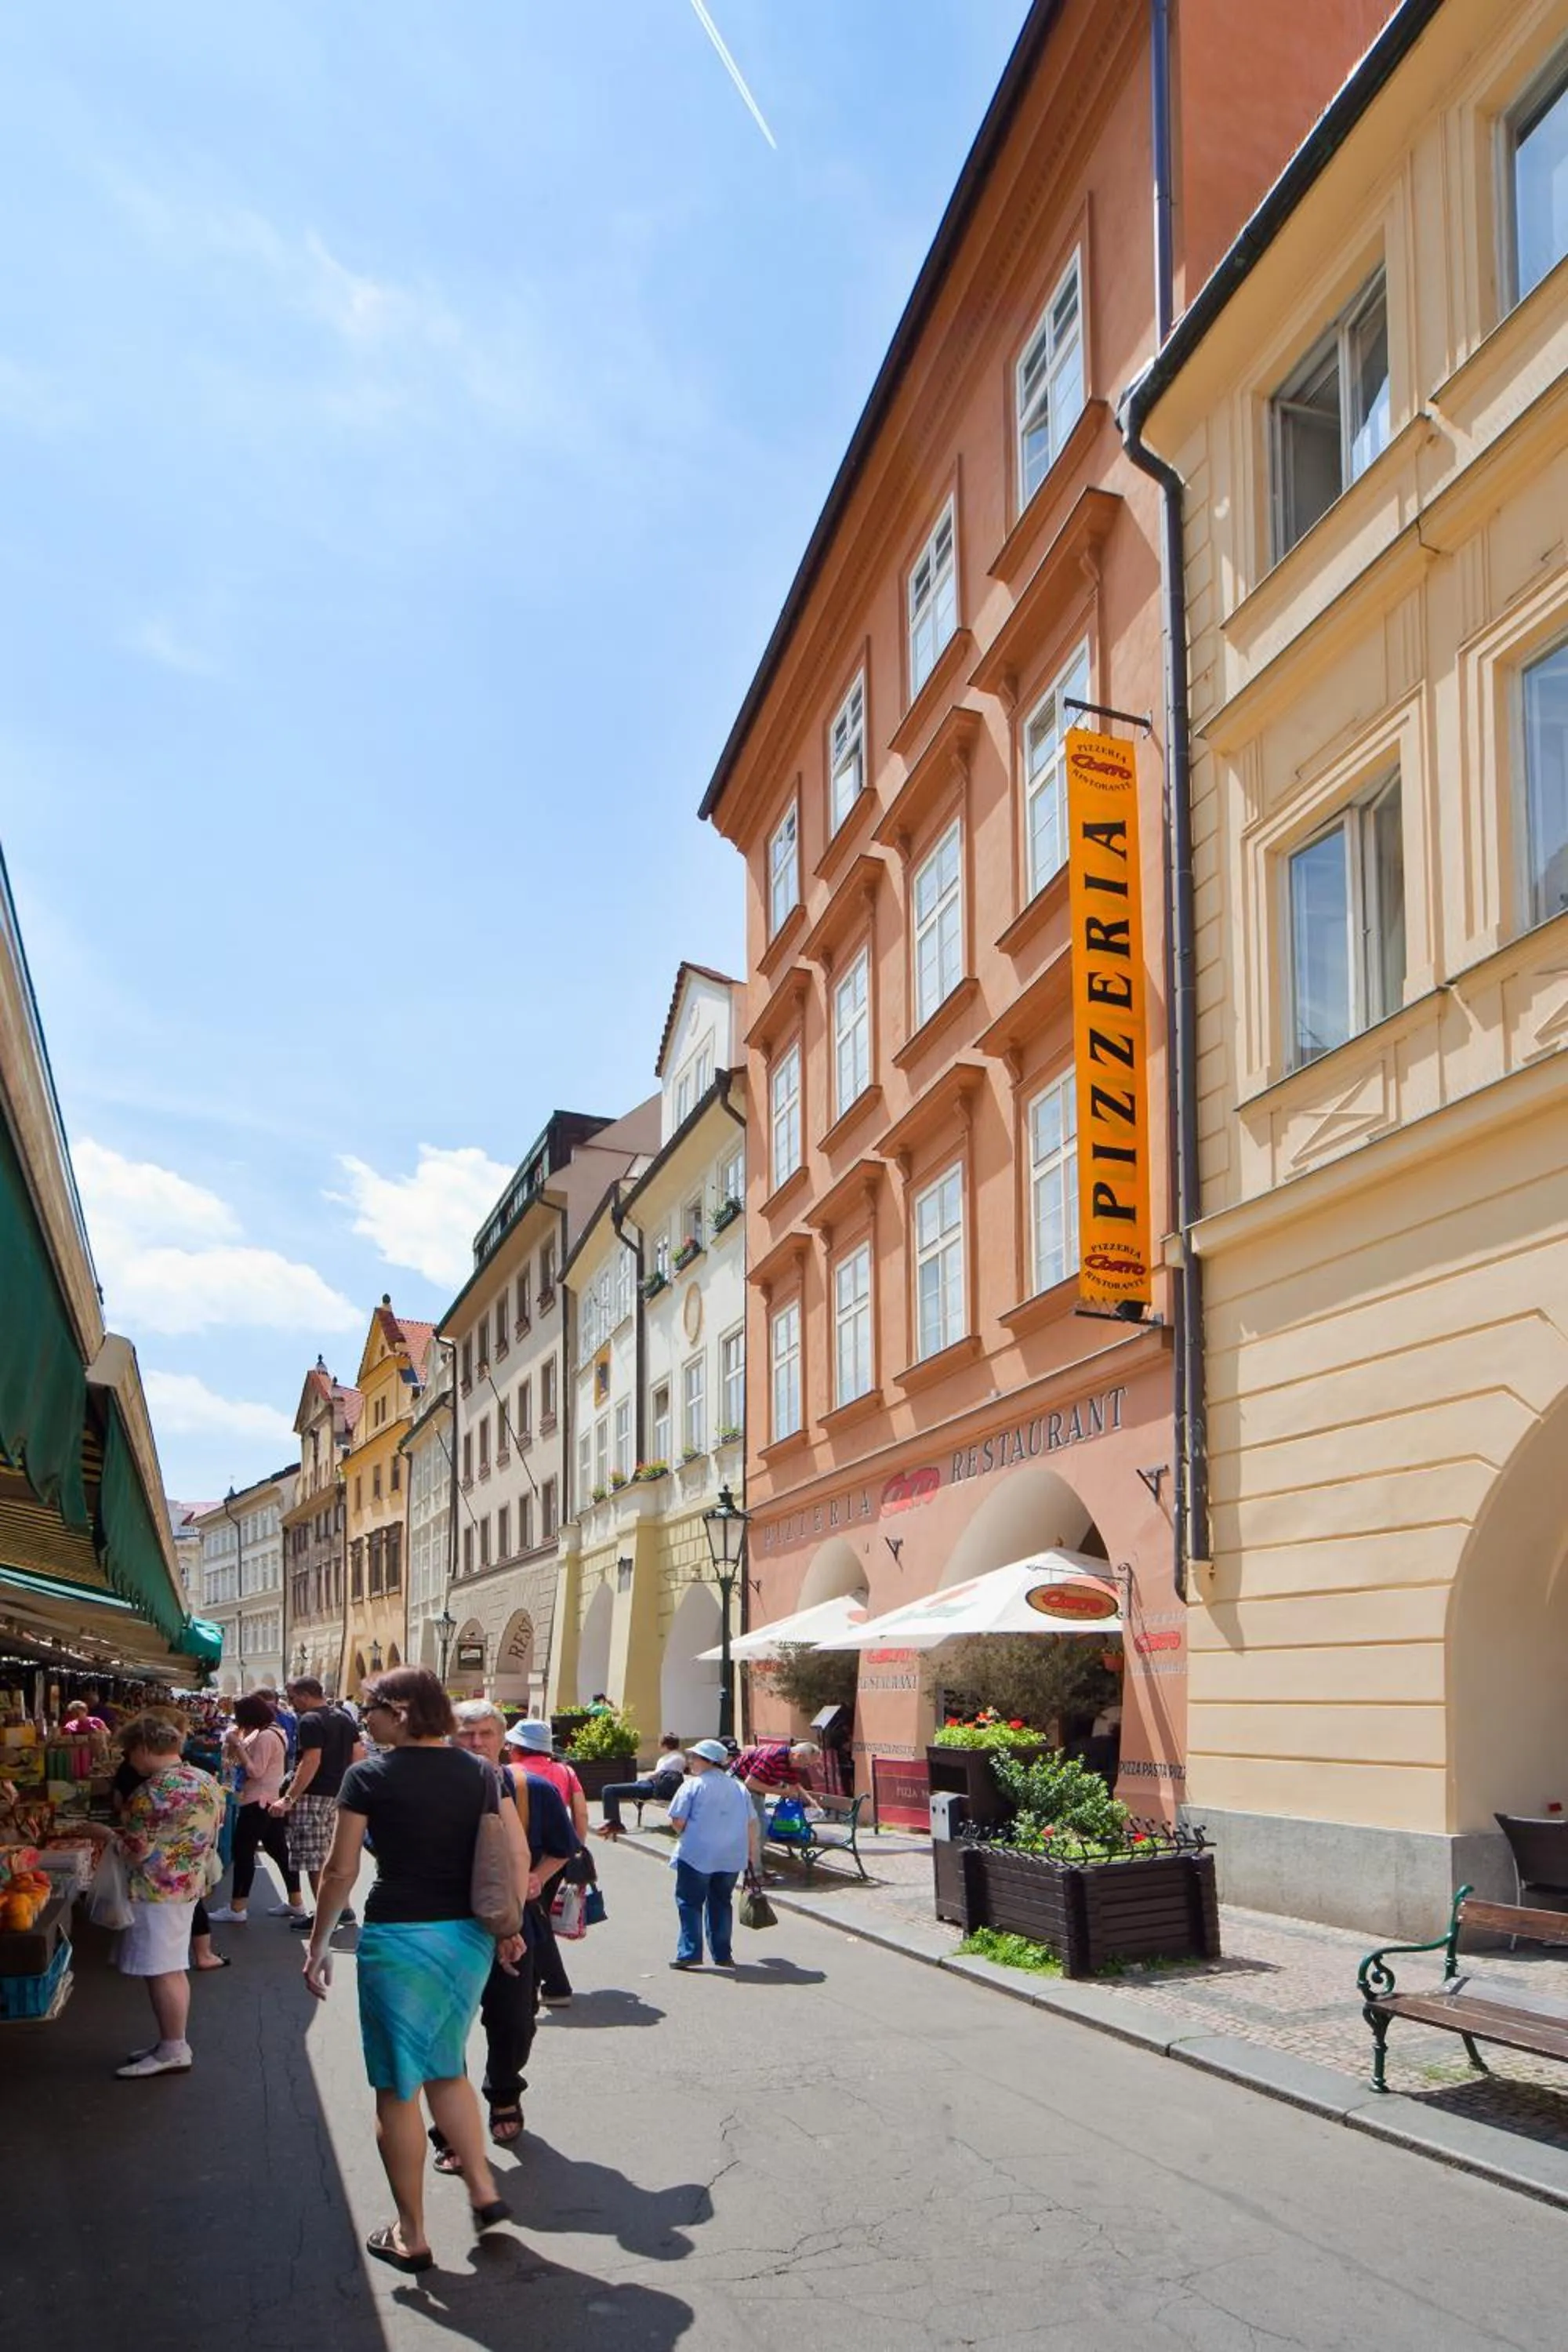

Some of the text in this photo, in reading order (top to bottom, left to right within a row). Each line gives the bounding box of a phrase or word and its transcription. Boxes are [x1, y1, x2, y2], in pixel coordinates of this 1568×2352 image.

[1076, 743, 1127, 764] PIZZERIA
[1082, 819, 1137, 1224] PIZZERIA
[1091, 1243, 1142, 1259] PIZZERIA
[950, 1385, 1128, 1485] RESTAURANT
